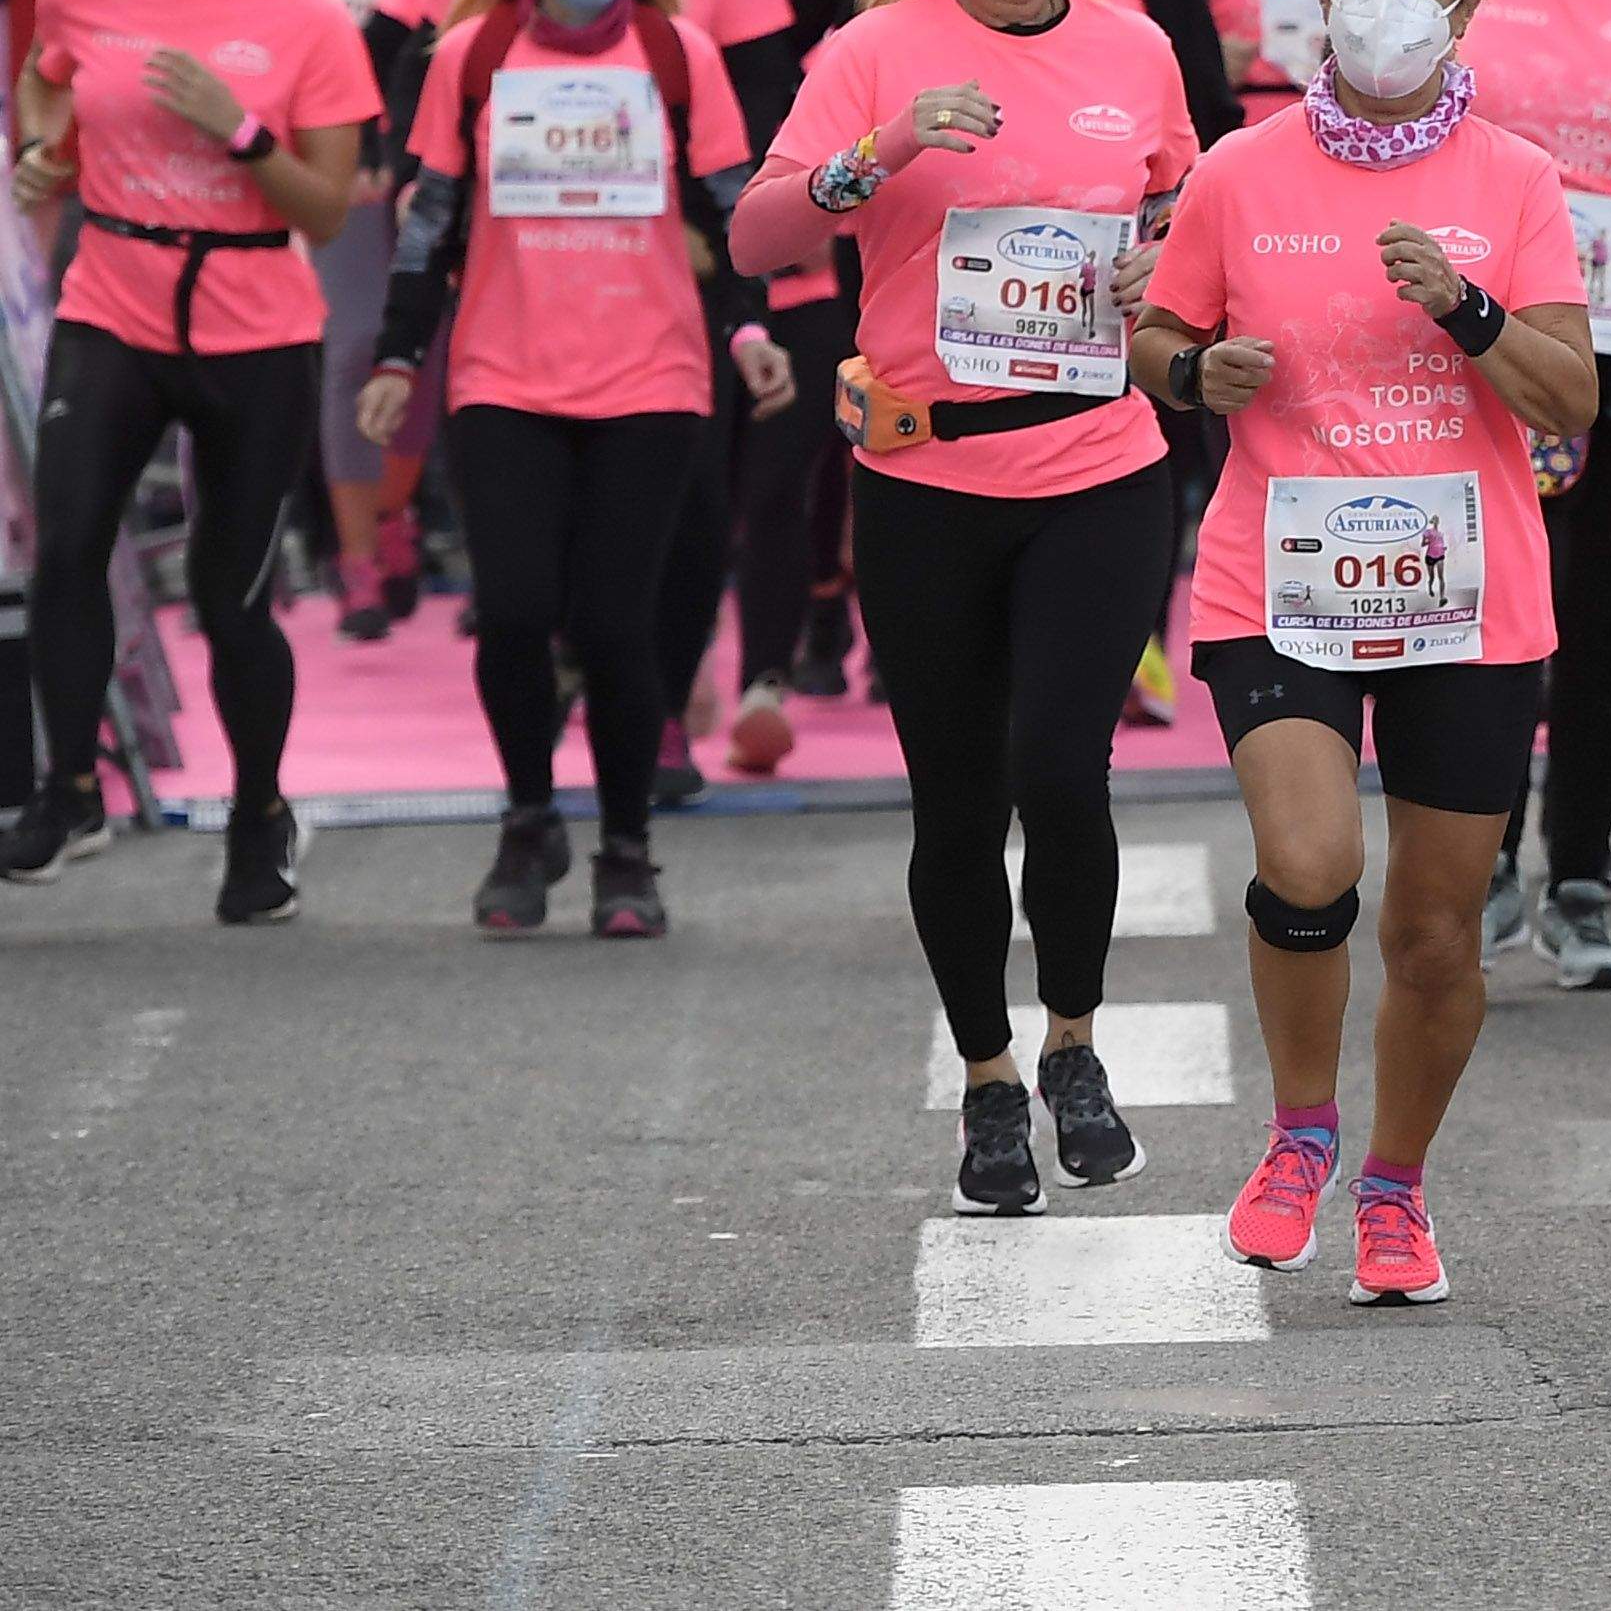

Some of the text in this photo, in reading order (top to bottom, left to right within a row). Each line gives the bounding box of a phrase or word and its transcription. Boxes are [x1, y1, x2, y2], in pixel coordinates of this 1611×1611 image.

[545, 125, 614, 153] 016
[1004, 238, 1080, 262] ASTURIANA
[1252, 234, 1342, 255] OYSHO
[1000, 277, 1078, 315] 016
[1015, 318, 1059, 337] 9879
[942, 353, 1001, 375] OYSHO
[1408, 353, 1465, 376] POR
[1369, 383, 1467, 409] TODAS
[1311, 416, 1465, 449] NOSOTRAS
[1332, 513, 1421, 533] ASTURIANA
[1334, 554, 1423, 589] 016
[1350, 597, 1407, 615] 10213
[1277, 608, 1475, 629] CURSA DE LES DONES DE BARCELONA
[1279, 639, 1344, 658] OYSHO
